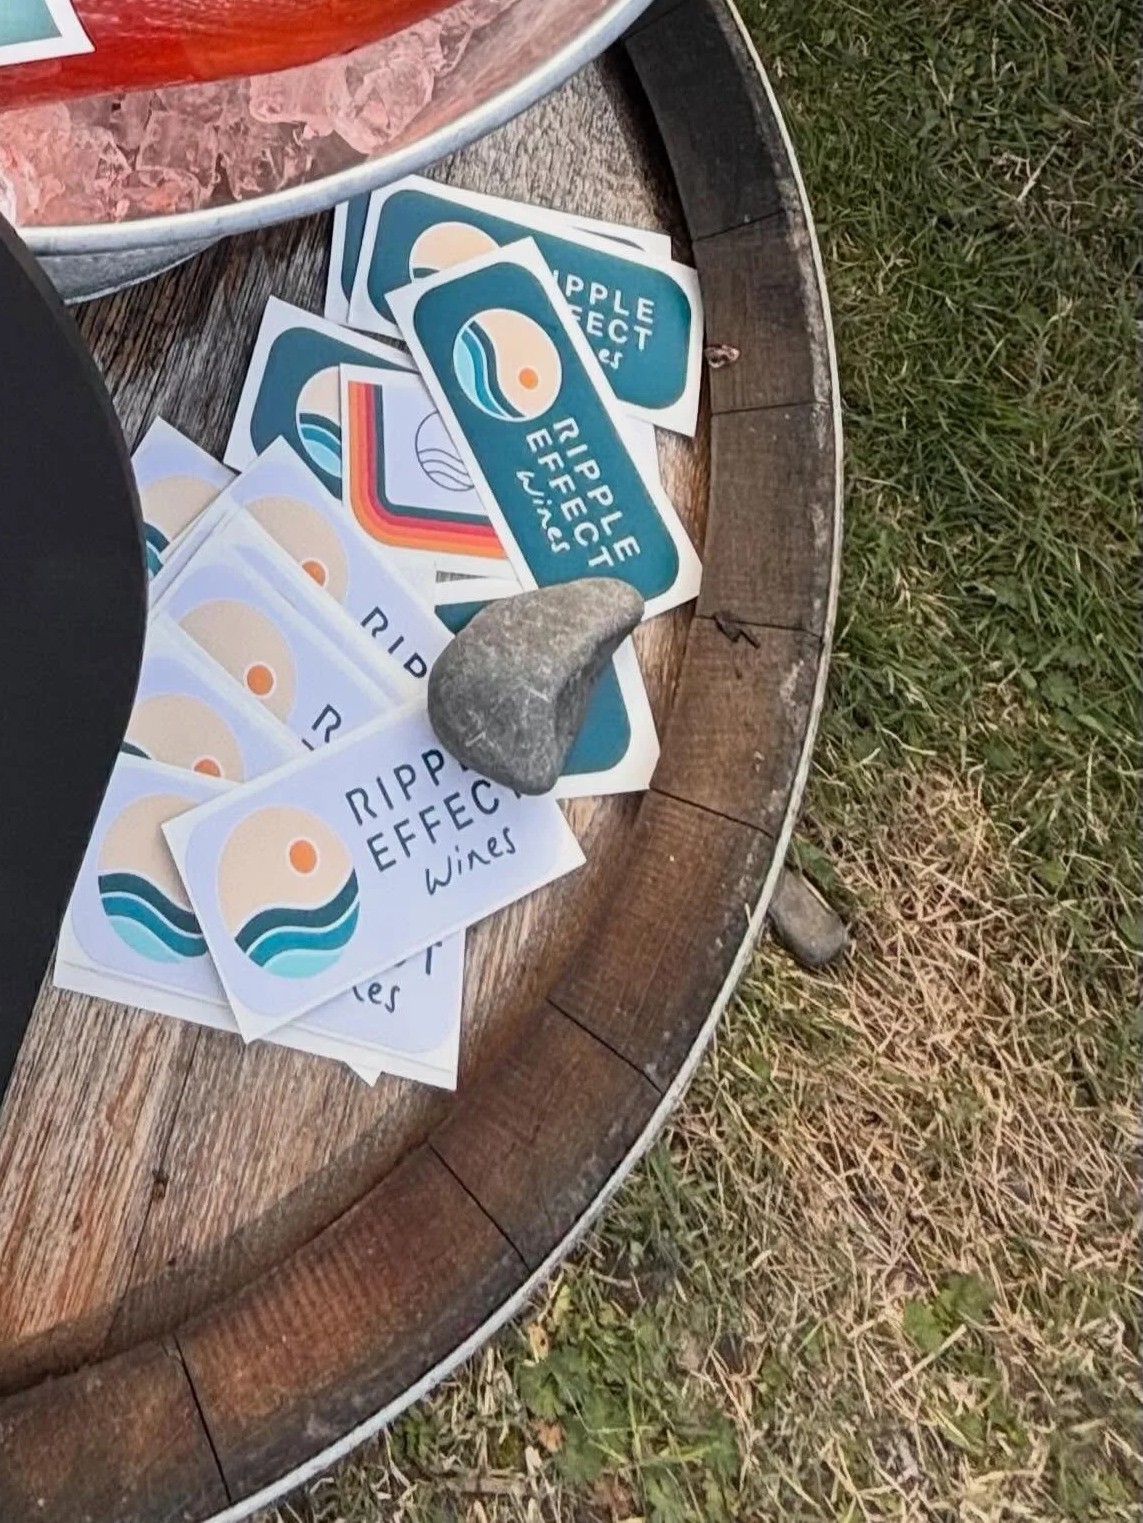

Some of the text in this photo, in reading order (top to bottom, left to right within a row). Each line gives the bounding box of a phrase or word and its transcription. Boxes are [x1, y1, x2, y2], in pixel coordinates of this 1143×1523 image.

[525, 428, 615, 568] EFFECT
[552, 417, 641, 563] RIPPLE
[345, 748, 469, 827] RIPP
[366, 778, 521, 873] EFFEC
